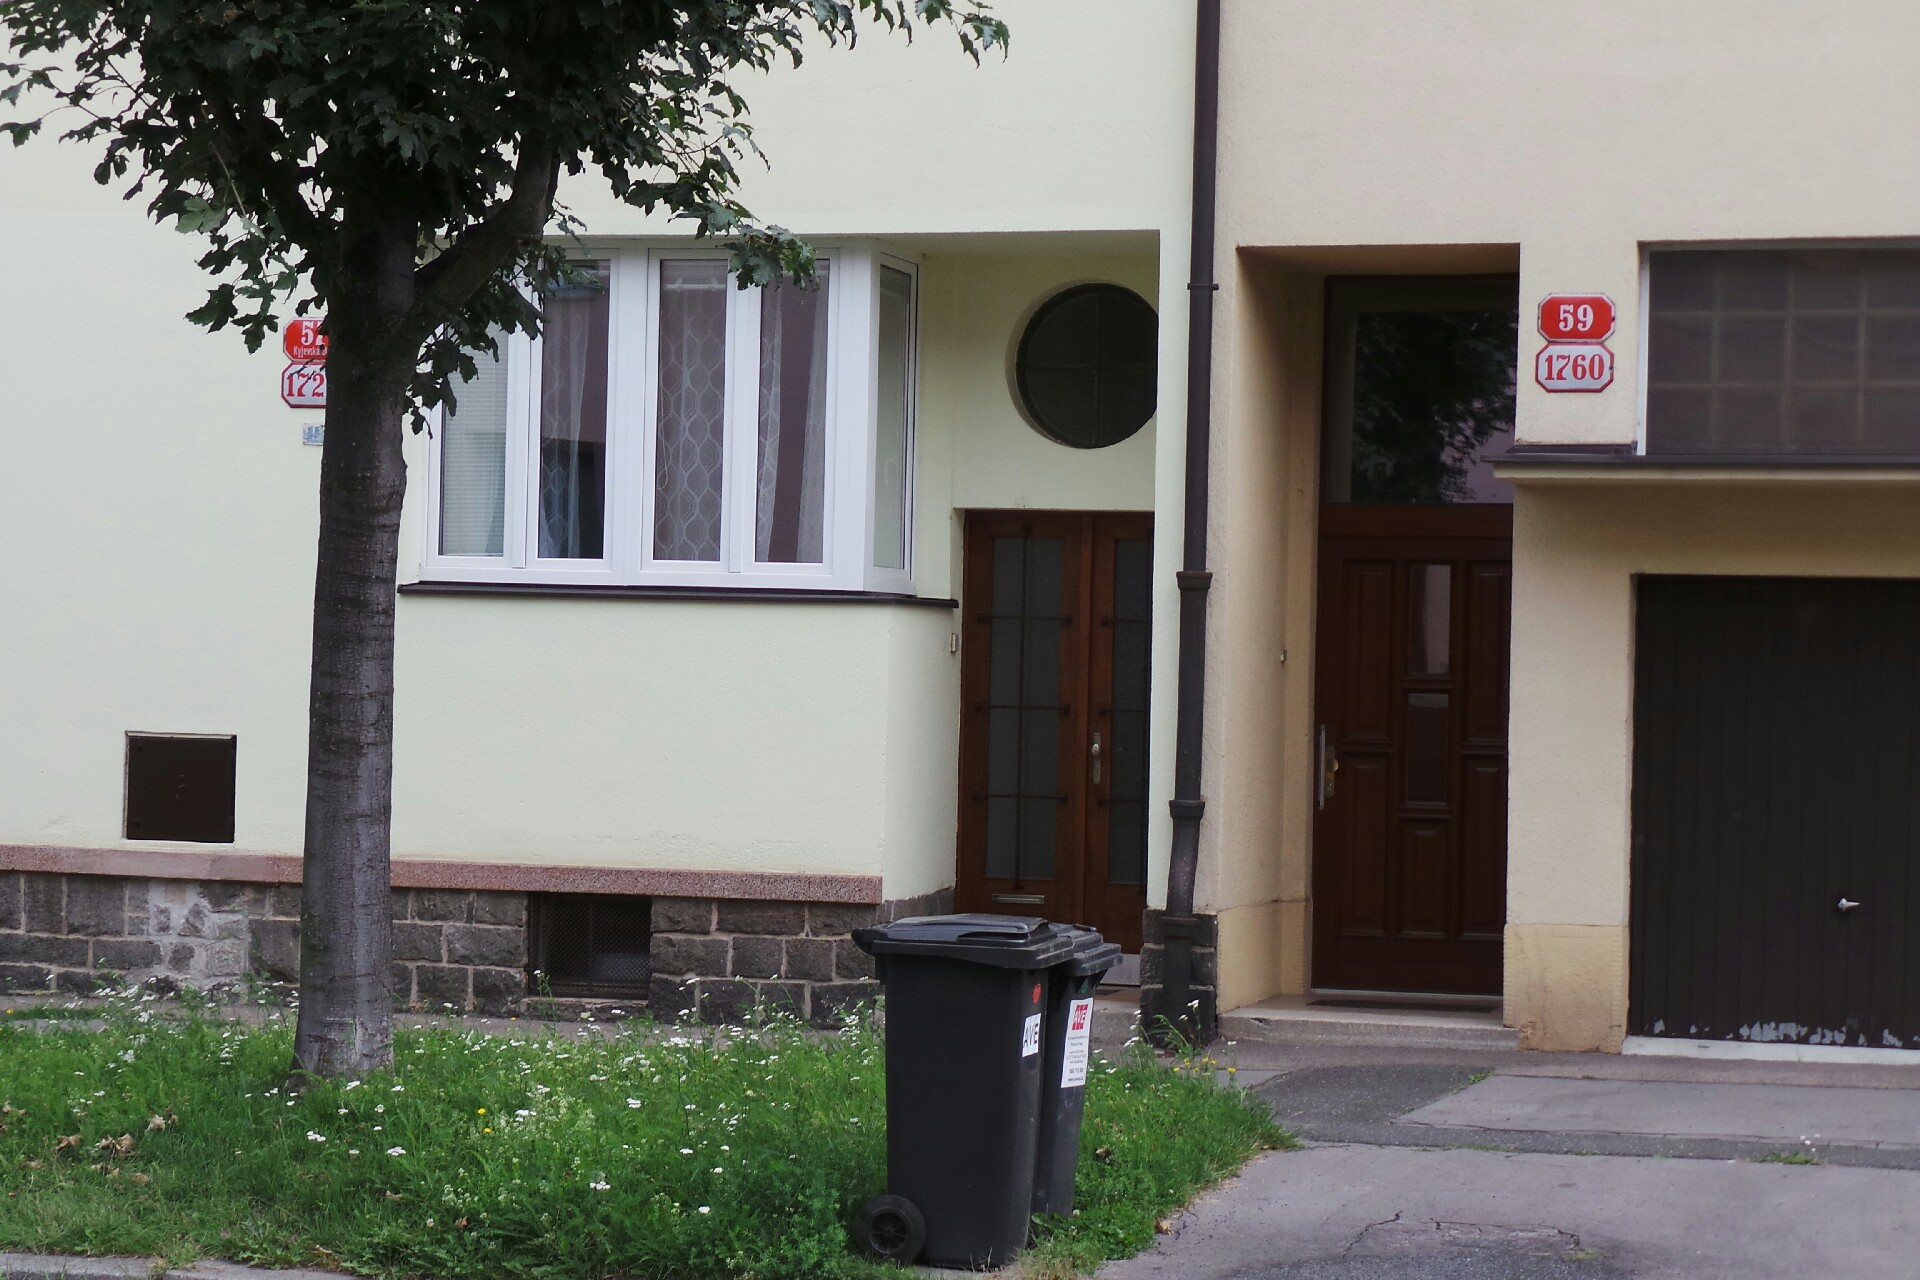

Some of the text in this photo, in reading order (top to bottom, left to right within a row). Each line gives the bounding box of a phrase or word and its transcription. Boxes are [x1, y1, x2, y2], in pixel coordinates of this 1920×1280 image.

[1558, 304, 1594, 332] 59
[1544, 353, 1605, 381] 1760
[286, 372, 325, 398] 172
[1022, 1022, 1039, 1048] AVE
